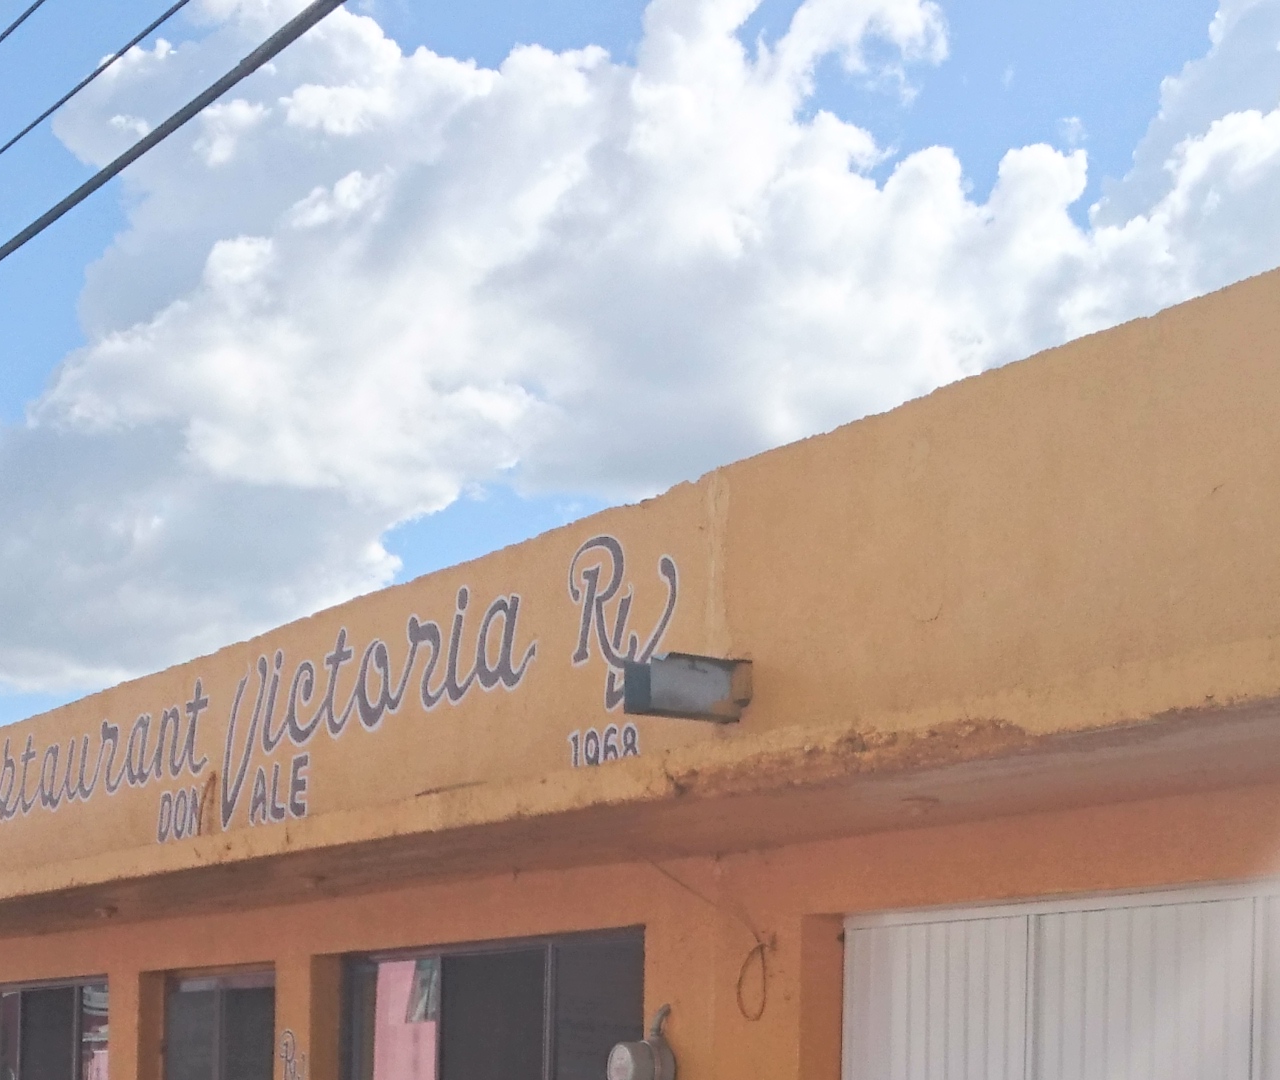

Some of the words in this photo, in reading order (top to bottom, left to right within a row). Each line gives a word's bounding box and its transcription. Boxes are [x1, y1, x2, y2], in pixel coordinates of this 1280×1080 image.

[220, 585, 538, 832] Victoria
[568, 723, 640, 767] 1968
[156, 783, 205, 843] DON
